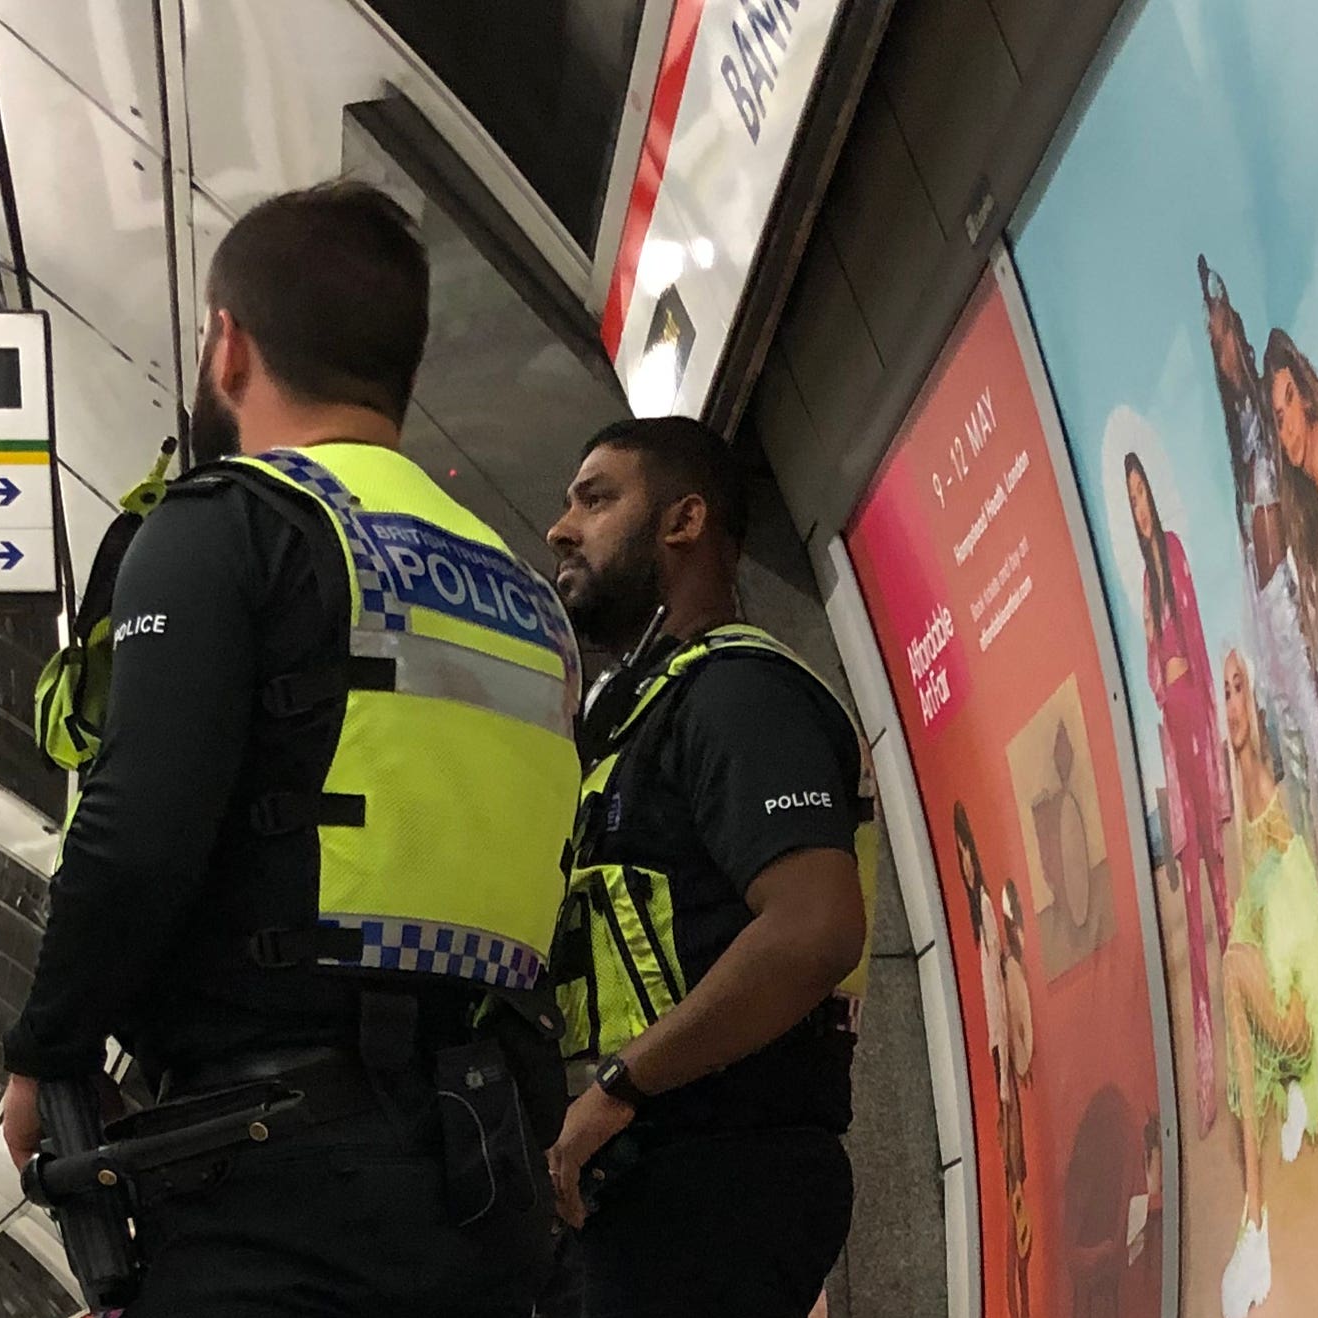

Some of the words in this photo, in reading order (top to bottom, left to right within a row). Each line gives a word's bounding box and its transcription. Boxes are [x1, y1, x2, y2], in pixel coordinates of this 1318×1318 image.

[720, 0, 800, 146] BAN
[932, 472, 946, 510] 9
[950, 436, 969, 482] 12
[964, 385, 997, 458] MAY
[113, 615, 168, 651] POLICE
[907, 602, 954, 687] Affordable
[919, 680, 939, 727] Art
[930, 668, 951, 709] Fair
[765, 791, 833, 815] POLICE
